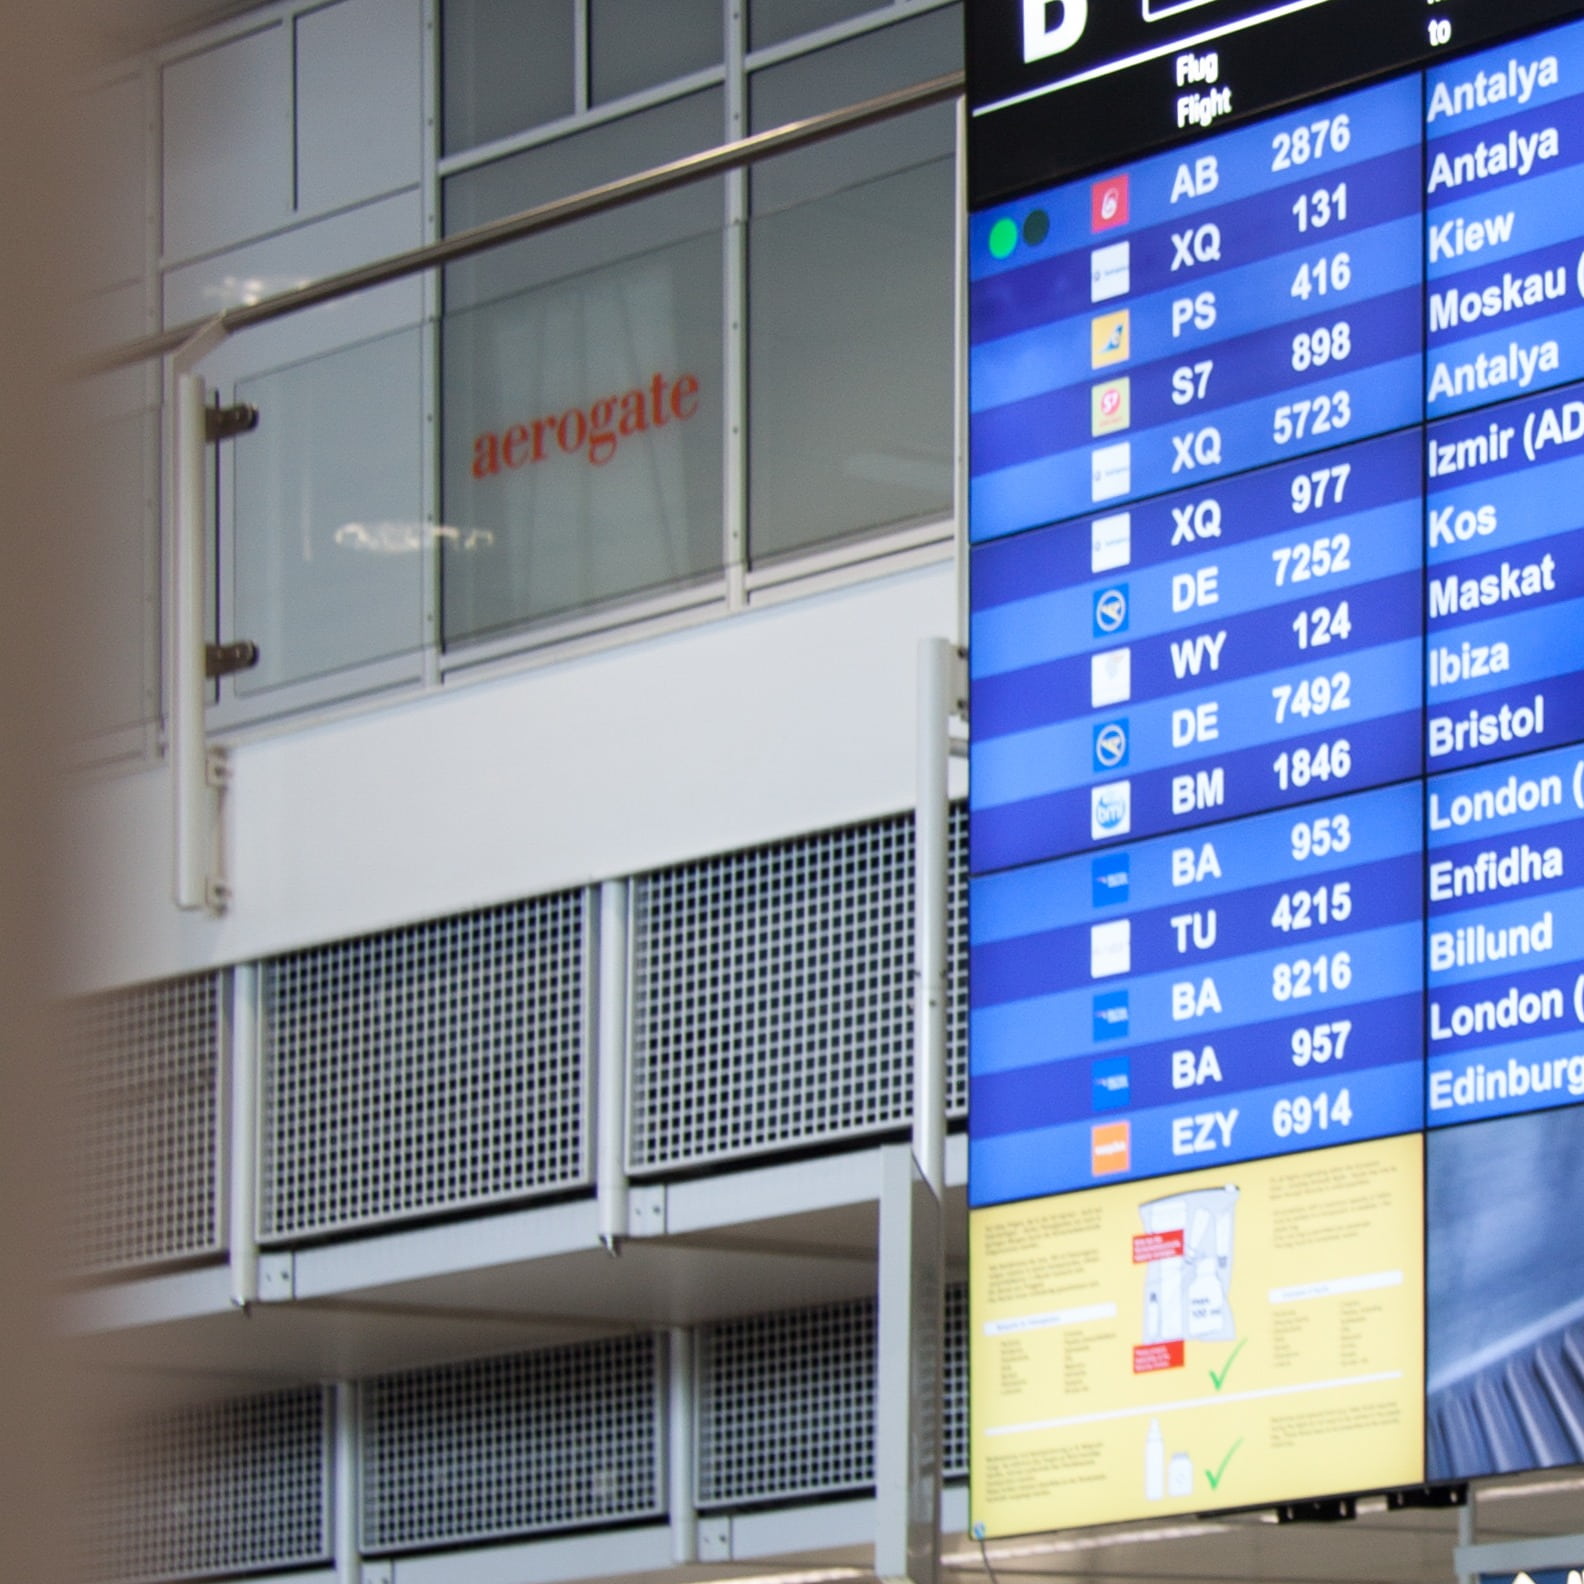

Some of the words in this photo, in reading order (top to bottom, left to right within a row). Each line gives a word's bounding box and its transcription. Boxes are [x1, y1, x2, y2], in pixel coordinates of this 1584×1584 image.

[1176, 53, 1219, 87] Flug
[1428, 19, 1452, 46] to
[1170, 156, 1219, 203] AB
[1271, 114, 1351, 172] 2876
[1427, 56, 1558, 121] Antalya
[1177, 87, 1232, 128] Flight
[1171, 223, 1221, 271] XQ
[1292, 183, 1346, 232] 131
[1428, 127, 1559, 193] Antalya
[1172, 292, 1216, 337] PS
[1291, 252, 1351, 300] 416
[1430, 212, 1515, 262] Kiew
[1172, 361, 1213, 405] S7
[1292, 322, 1351, 371] 898
[1430, 267, 1566, 332] Moskau
[472, 372, 699, 479] aerogate
[1172, 427, 1221, 473] XQ
[1273, 390, 1351, 444] 5723
[1428, 340, 1559, 401] Antalya
[1171, 499, 1221, 546] XQ
[1291, 463, 1351, 513] 977
[1429, 423, 1515, 477] Izmir
[1172, 565, 1219, 613] DE
[1272, 533, 1351, 587] 7252
[1429, 505, 1497, 547] Kos
[1170, 631, 1227, 679] WY
[1292, 601, 1352, 649] 124
[1430, 554, 1555, 617] Maskat
[1172, 701, 1219, 748] DE
[1271, 671, 1351, 724] 7492
[1430, 642, 1510, 686] Ibiza
[1172, 768, 1224, 814] BM
[1273, 739, 1351, 790] 1846
[1430, 695, 1544, 756] Bristol
[1172, 843, 1222, 886] BA
[1291, 814, 1351, 861] 953
[1430, 775, 1562, 830] London
[1170, 910, 1216, 953] TU
[1271, 882, 1352, 932] 4215
[1430, 845, 1563, 901] Enfidha
[1172, 977, 1222, 1021] BA
[1272, 951, 1352, 1002] 8216
[1431, 911, 1553, 971] Billund
[1172, 1046, 1222, 1089] BA
[1291, 1020, 1351, 1067] 957
[1431, 988, 1563, 1039] London
[1172, 1108, 1239, 1156] EZY
[1272, 1089, 1353, 1137] 6914
